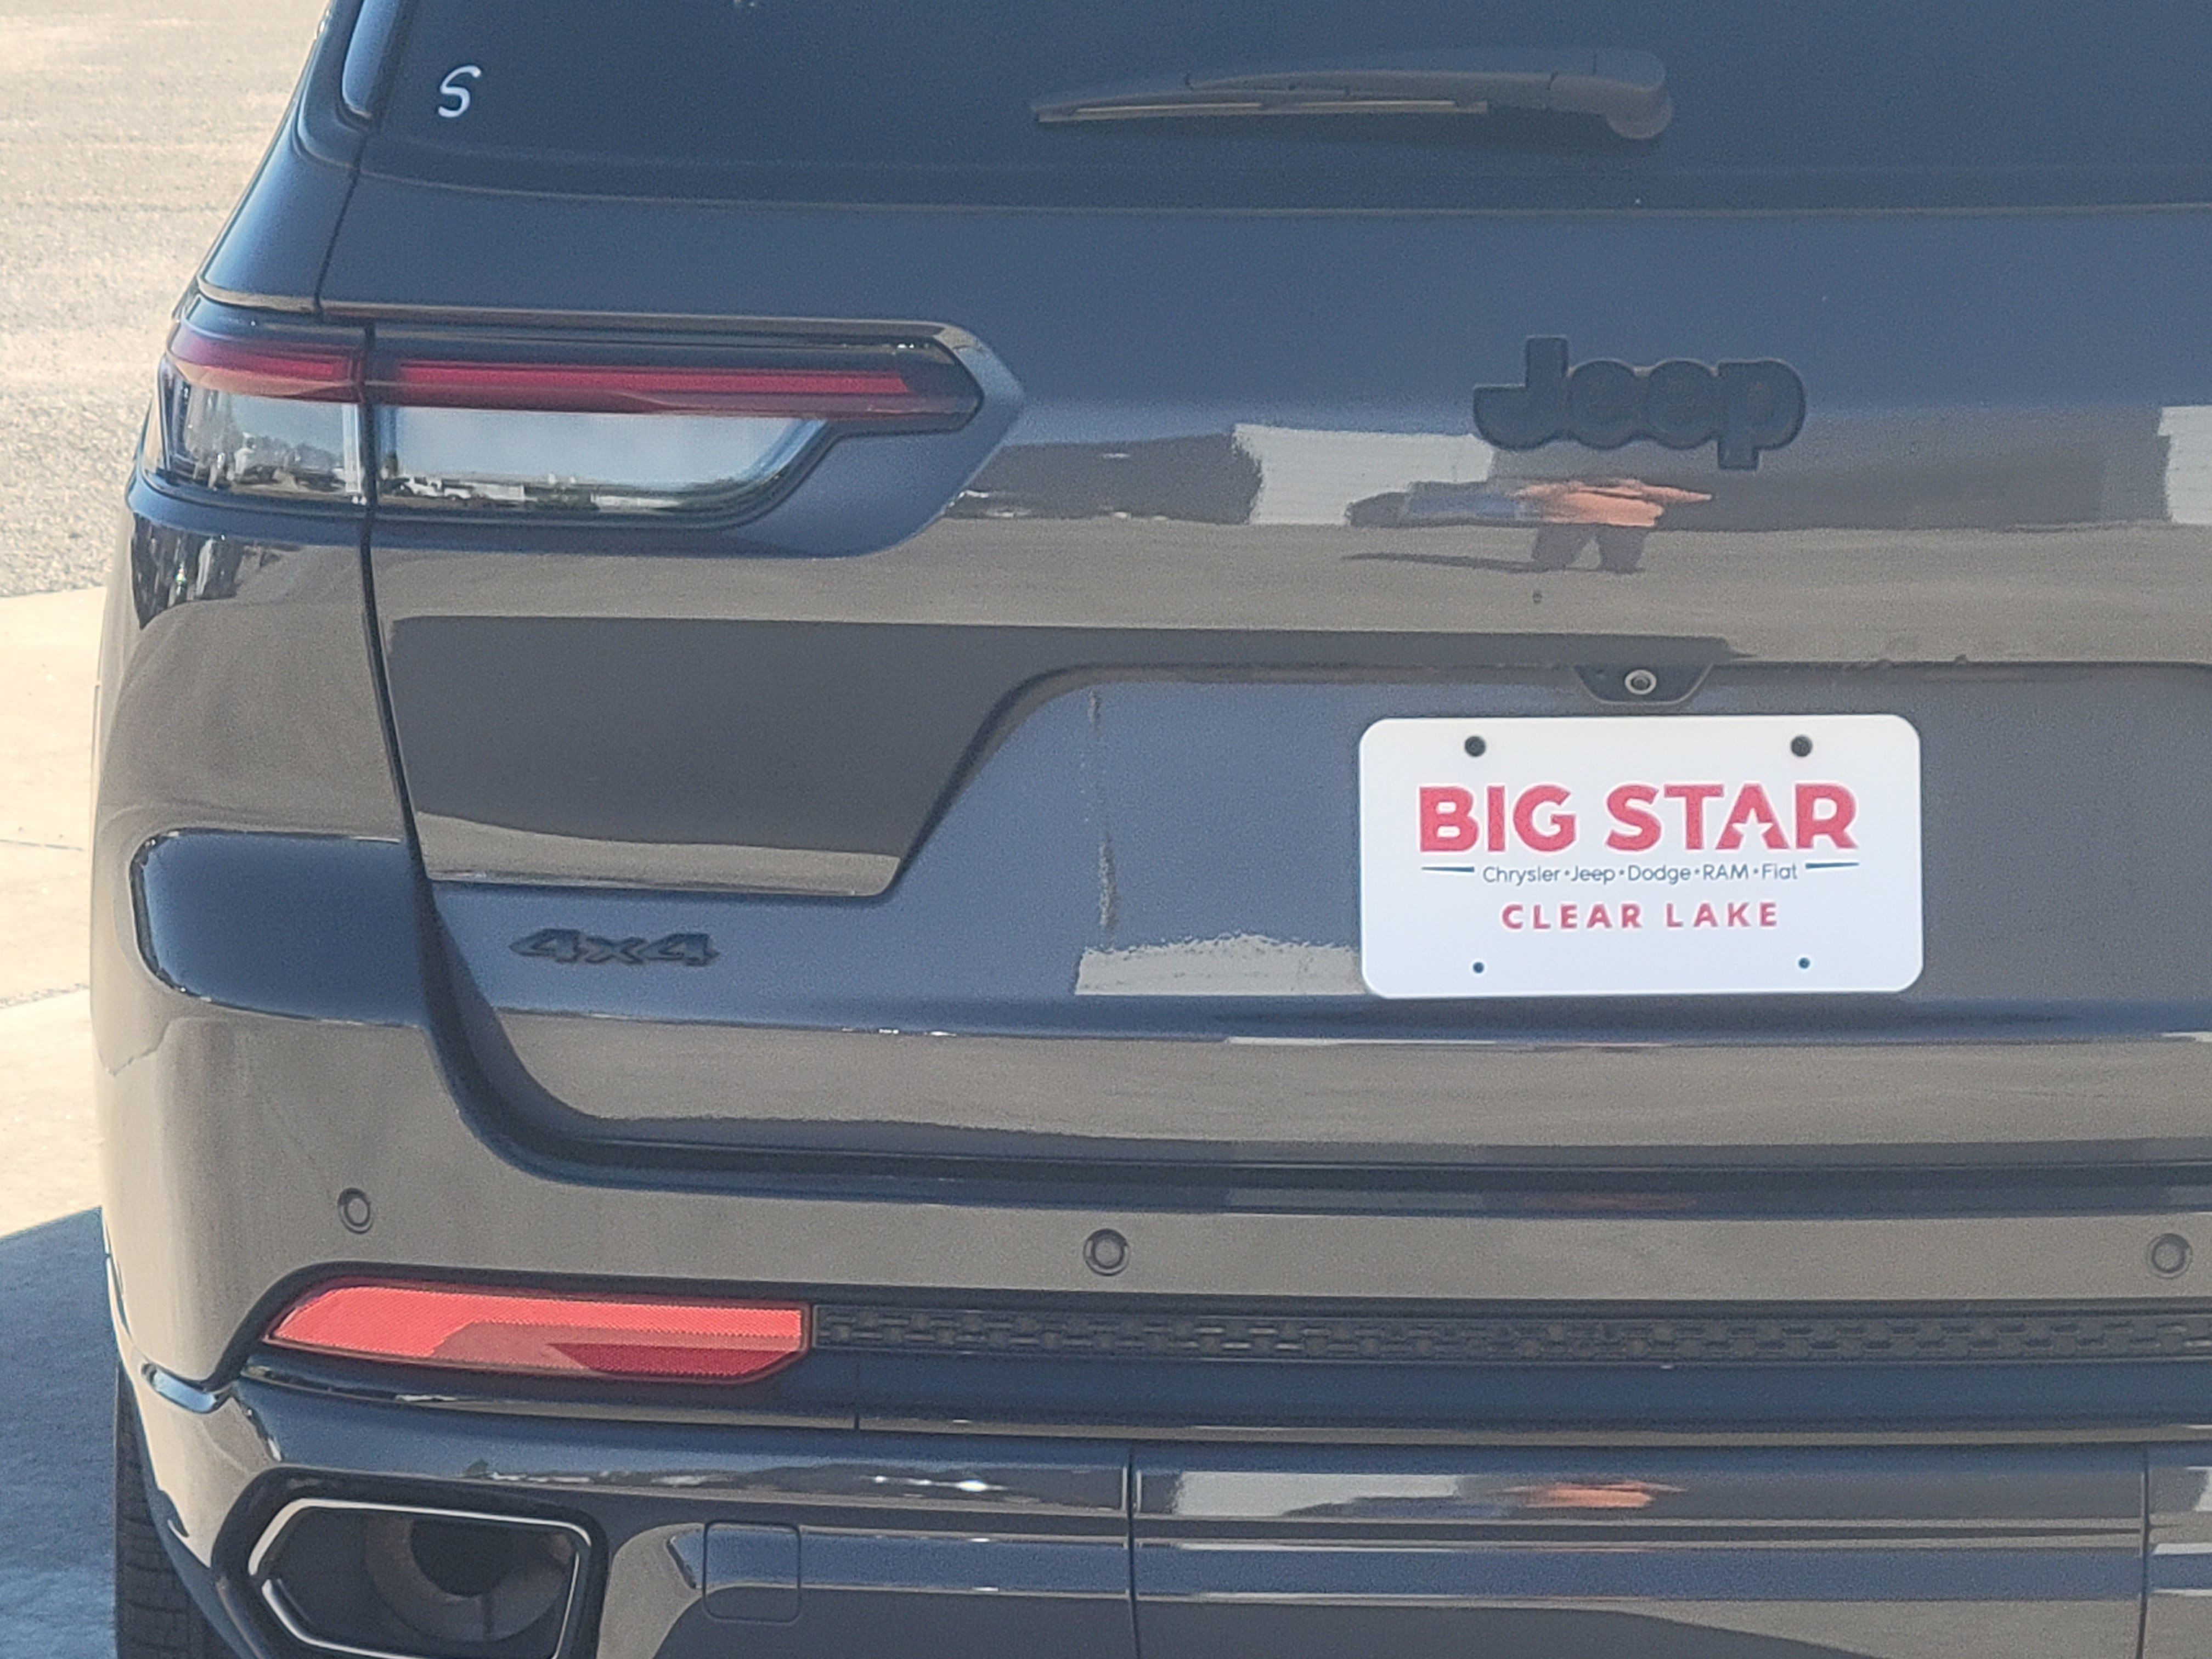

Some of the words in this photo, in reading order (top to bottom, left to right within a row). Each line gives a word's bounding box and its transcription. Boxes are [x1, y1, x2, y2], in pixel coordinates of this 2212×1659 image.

[1473, 335, 1806, 470] Jeep
[1419, 785, 1576, 853] BIG
[1605, 782, 1859, 852] STAR
[1482, 866, 1561, 887] Chrysler
[1571, 865, 1616, 885] Jeep
[1628, 864, 1691, 885] Dodge
[1703, 864, 1749, 880] RAM
[1762, 863, 1797, 879] Fiat
[1502, 904, 1641, 930] CLEAR
[1666, 902, 1778, 928] LAKE
